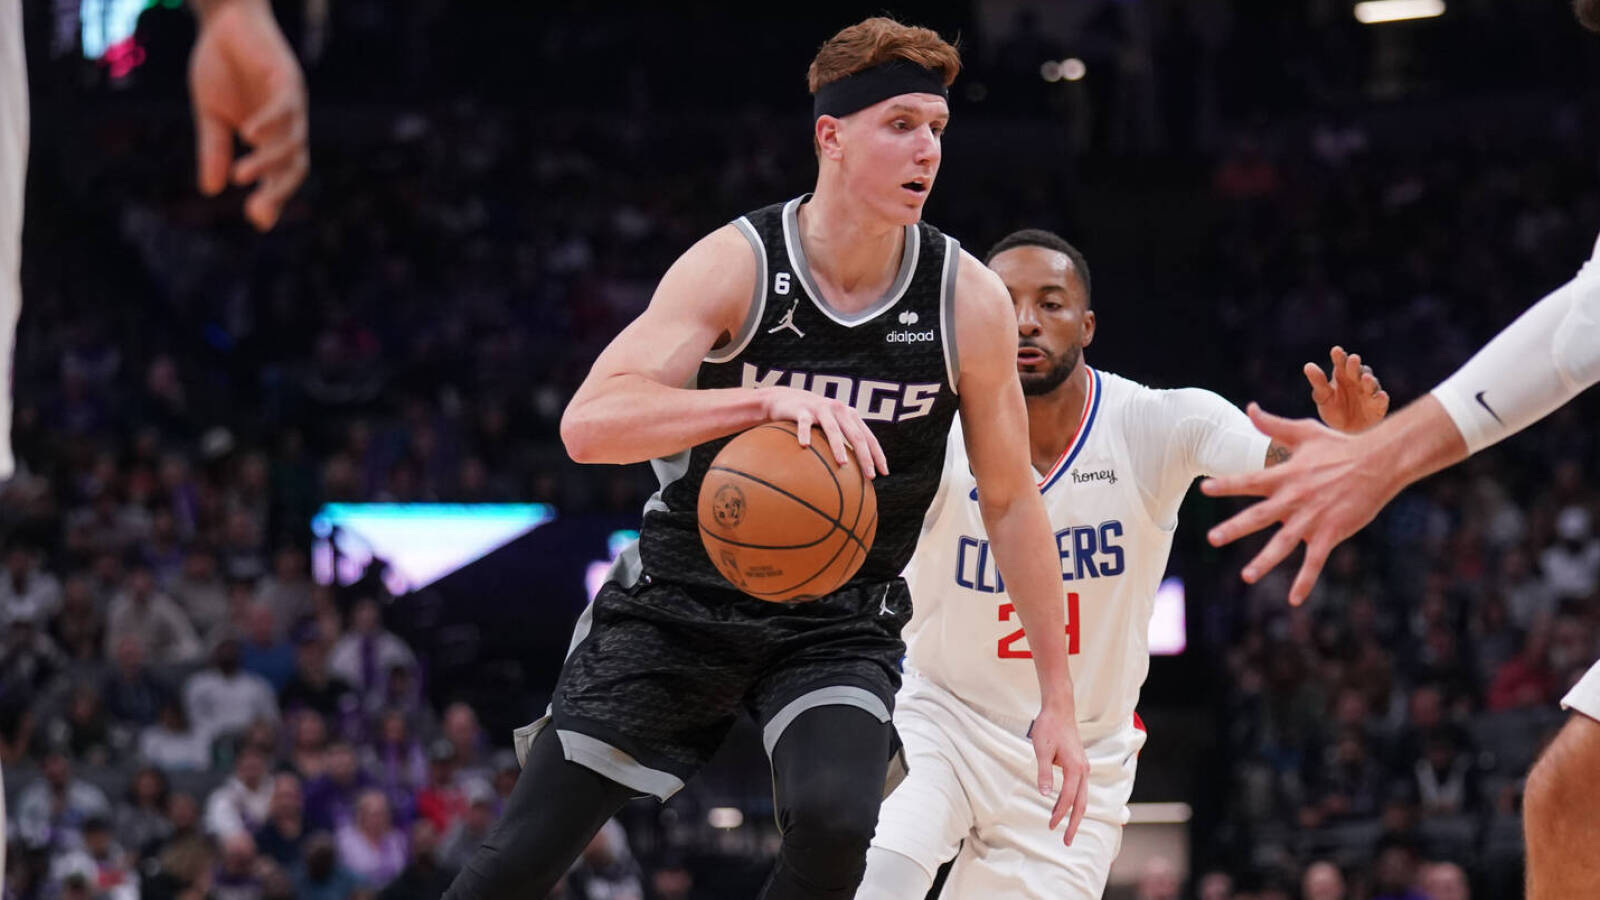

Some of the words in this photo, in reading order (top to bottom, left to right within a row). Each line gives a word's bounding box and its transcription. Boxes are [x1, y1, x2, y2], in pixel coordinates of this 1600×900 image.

[774, 272, 791, 295] 6
[886, 329, 934, 345] dialpad
[1071, 467, 1119, 485] honey
[955, 519, 1125, 593] CLERS
